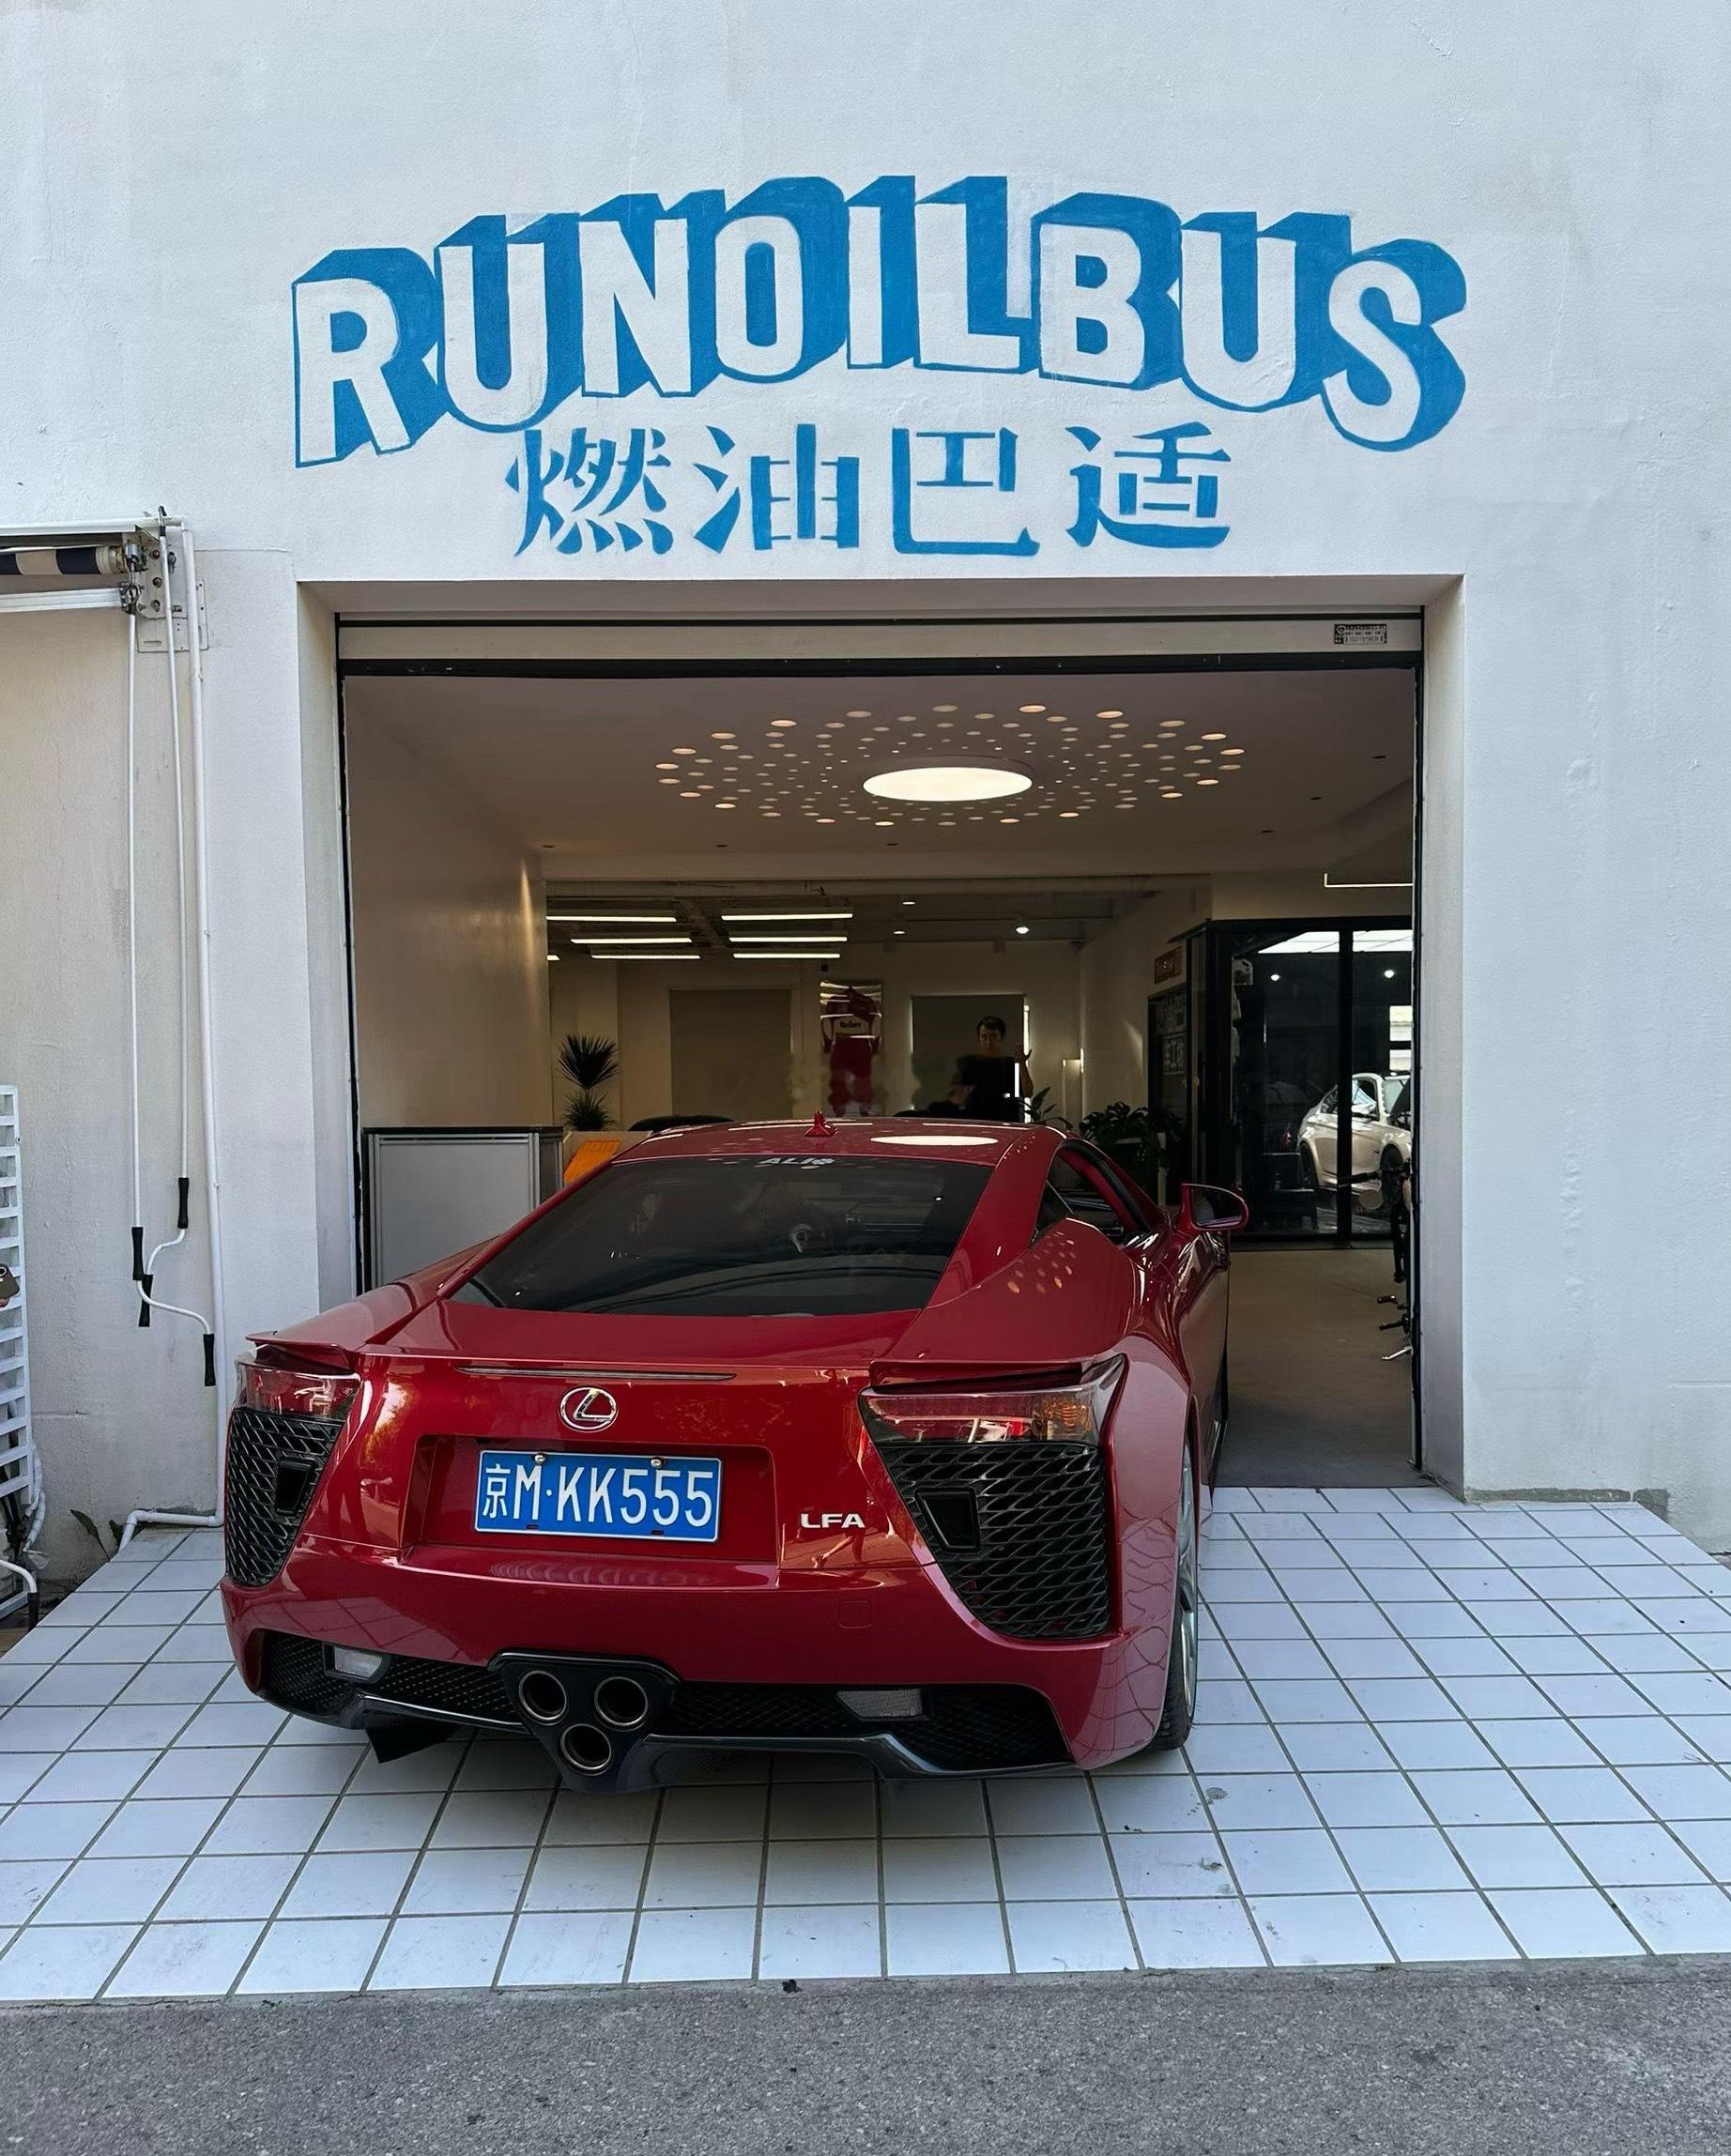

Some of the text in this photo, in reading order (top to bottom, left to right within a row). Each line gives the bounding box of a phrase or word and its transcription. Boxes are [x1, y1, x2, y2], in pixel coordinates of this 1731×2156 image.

[505, 422, 1231, 558] 燃油巴适
[482, 1462, 714, 1528] 京M·KK555
[800, 1512, 866, 1529] LFA
